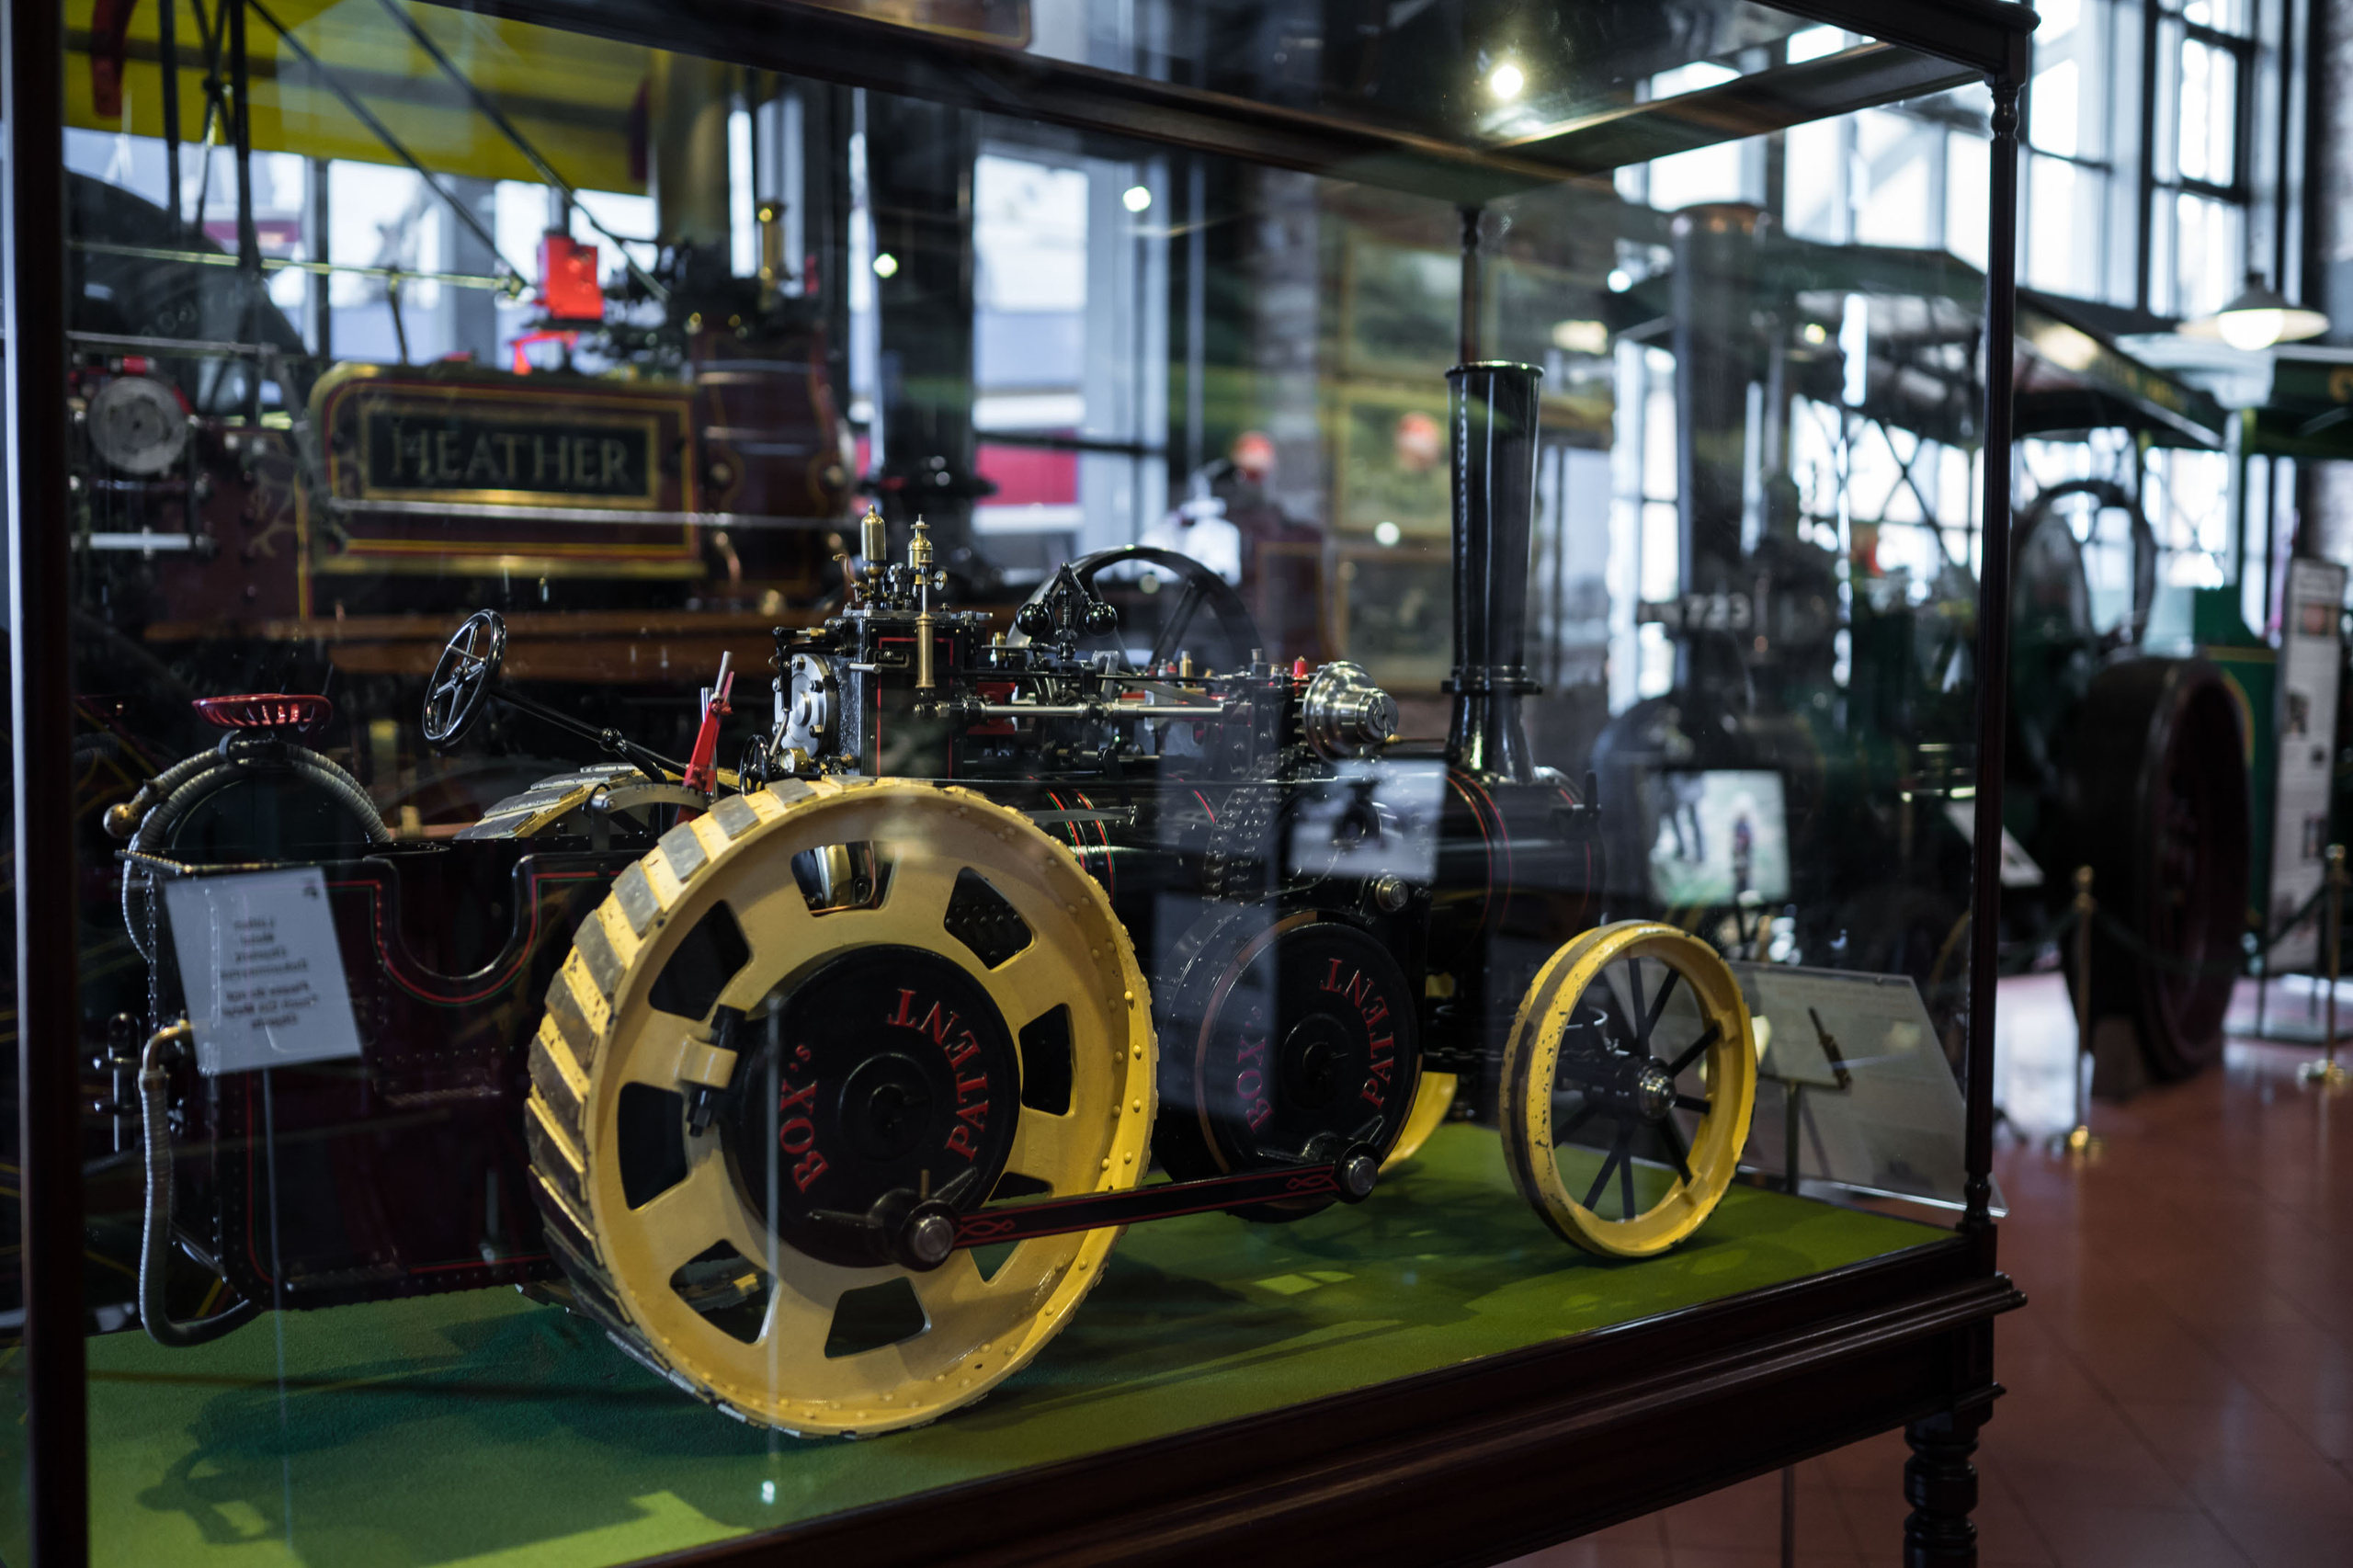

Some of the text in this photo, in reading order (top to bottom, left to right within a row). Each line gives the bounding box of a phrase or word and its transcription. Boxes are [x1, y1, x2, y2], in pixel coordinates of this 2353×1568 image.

[392, 424, 637, 487] HEATHER
[888, 988, 989, 1162] PATENT
[1319, 958, 1394, 1109] PATENT
